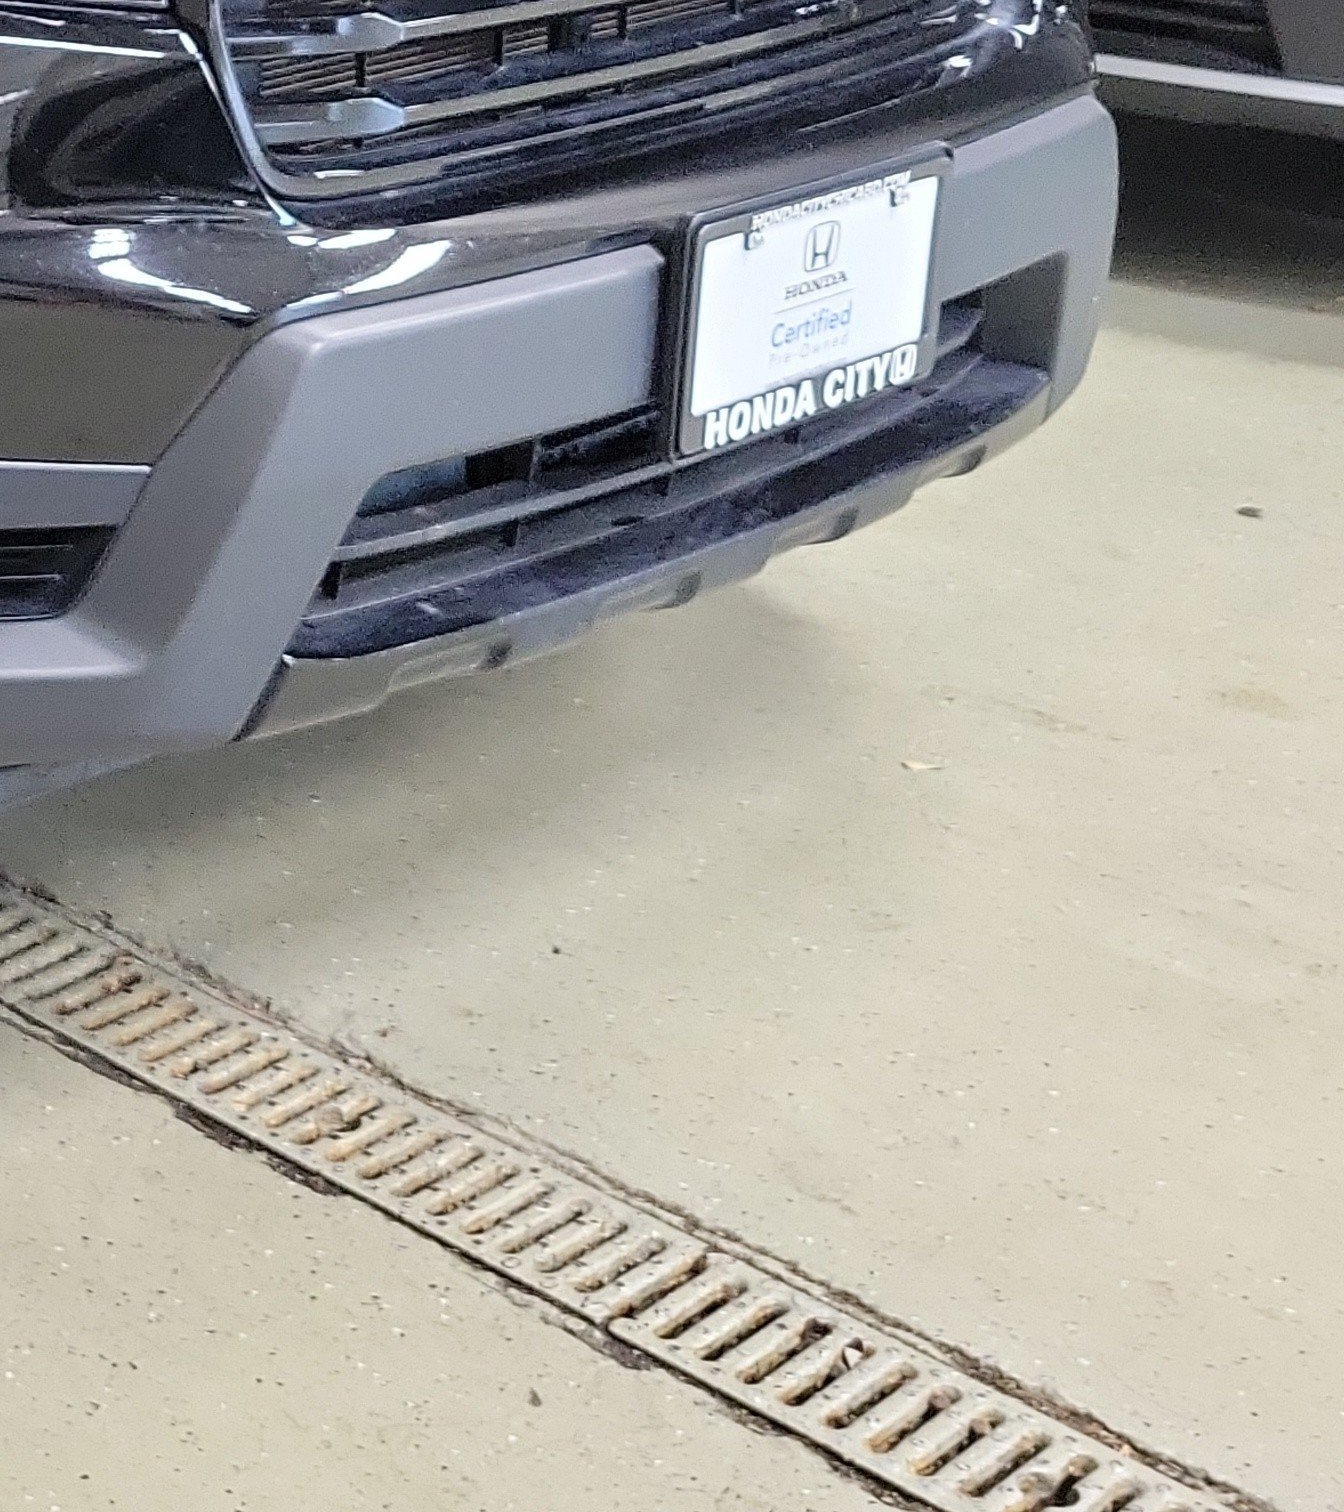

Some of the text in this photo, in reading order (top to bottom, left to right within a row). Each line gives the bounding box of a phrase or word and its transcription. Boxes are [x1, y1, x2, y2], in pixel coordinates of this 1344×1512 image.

[784, 270, 848, 300] HONDA
[771, 296, 853, 348] Certified
[703, 379, 818, 450] HONDA
[822, 351, 892, 409] CITY
